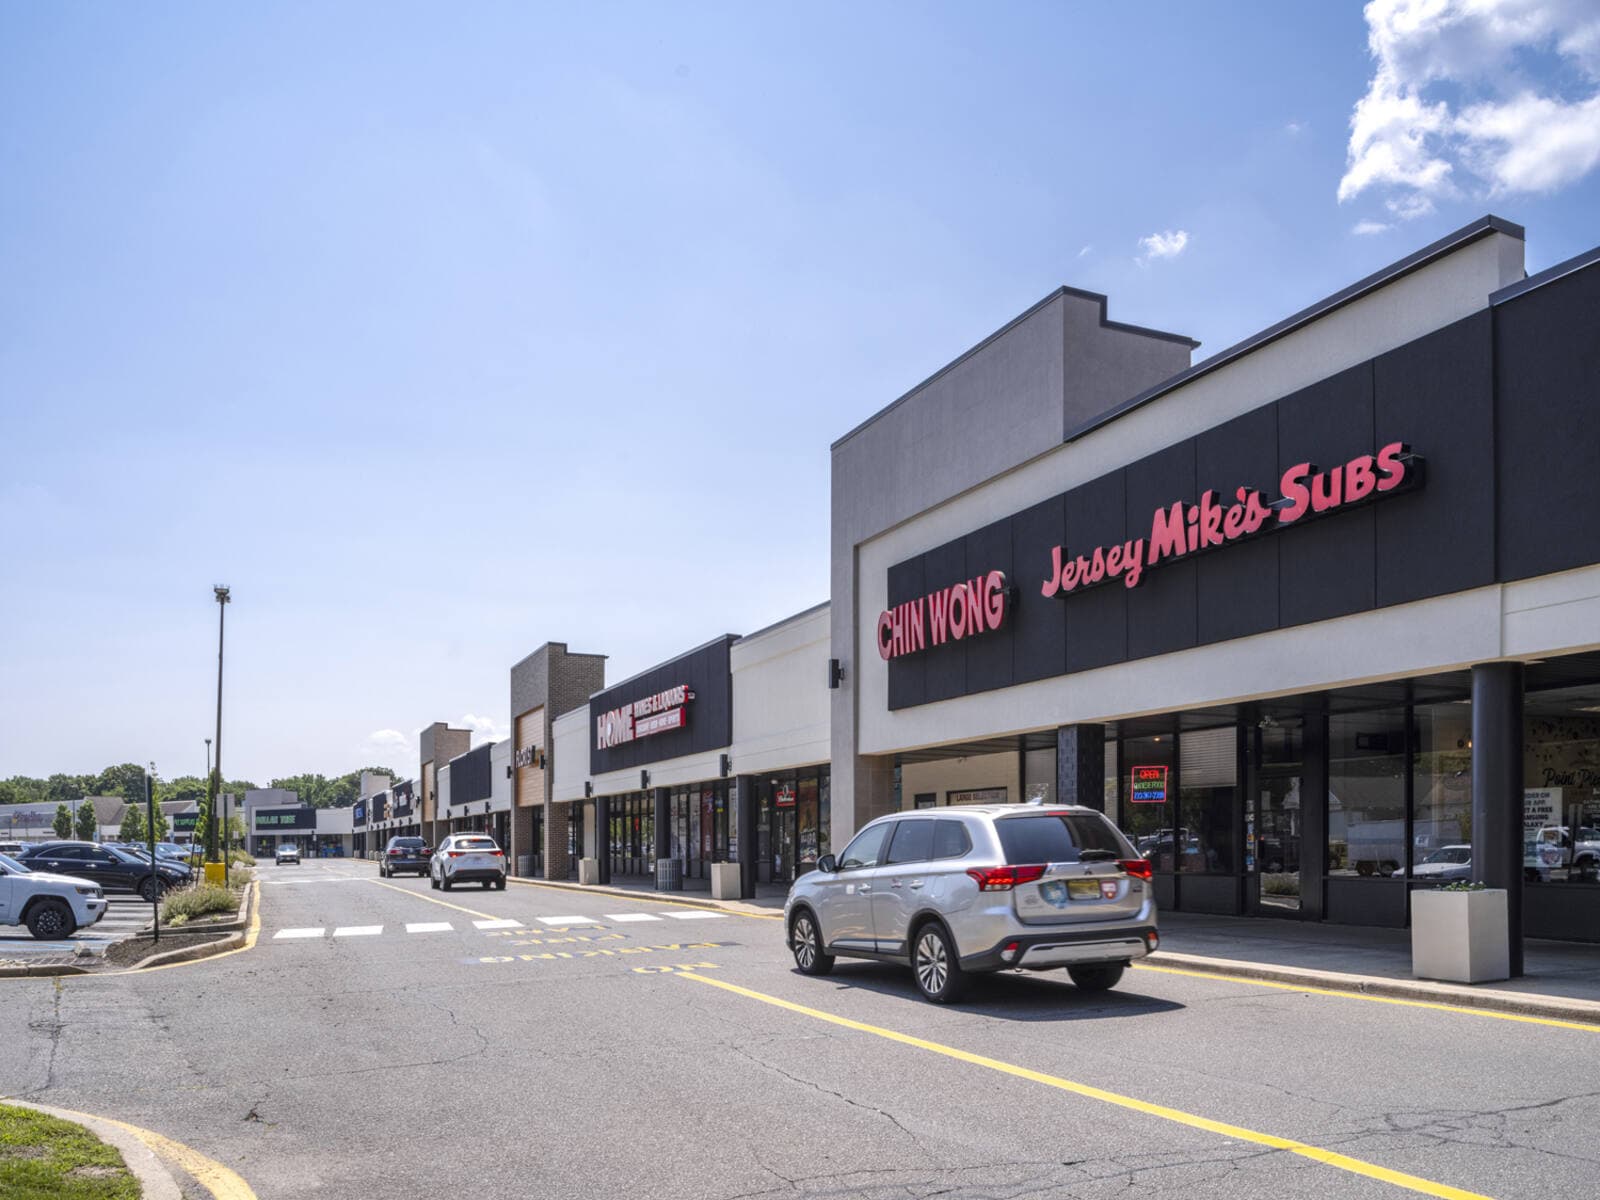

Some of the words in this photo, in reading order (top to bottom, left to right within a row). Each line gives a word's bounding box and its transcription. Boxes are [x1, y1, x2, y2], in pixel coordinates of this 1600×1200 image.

[1041, 538, 1144, 598] Jersey
[1147, 486, 1271, 566] Mike's
[877, 597, 926, 661] CHIN
[928, 569, 1007, 646] WONG
[597, 703, 634, 750] HOME
[1140, 769, 1160, 778] OPEN
[1542, 767, 1575, 788] Point
